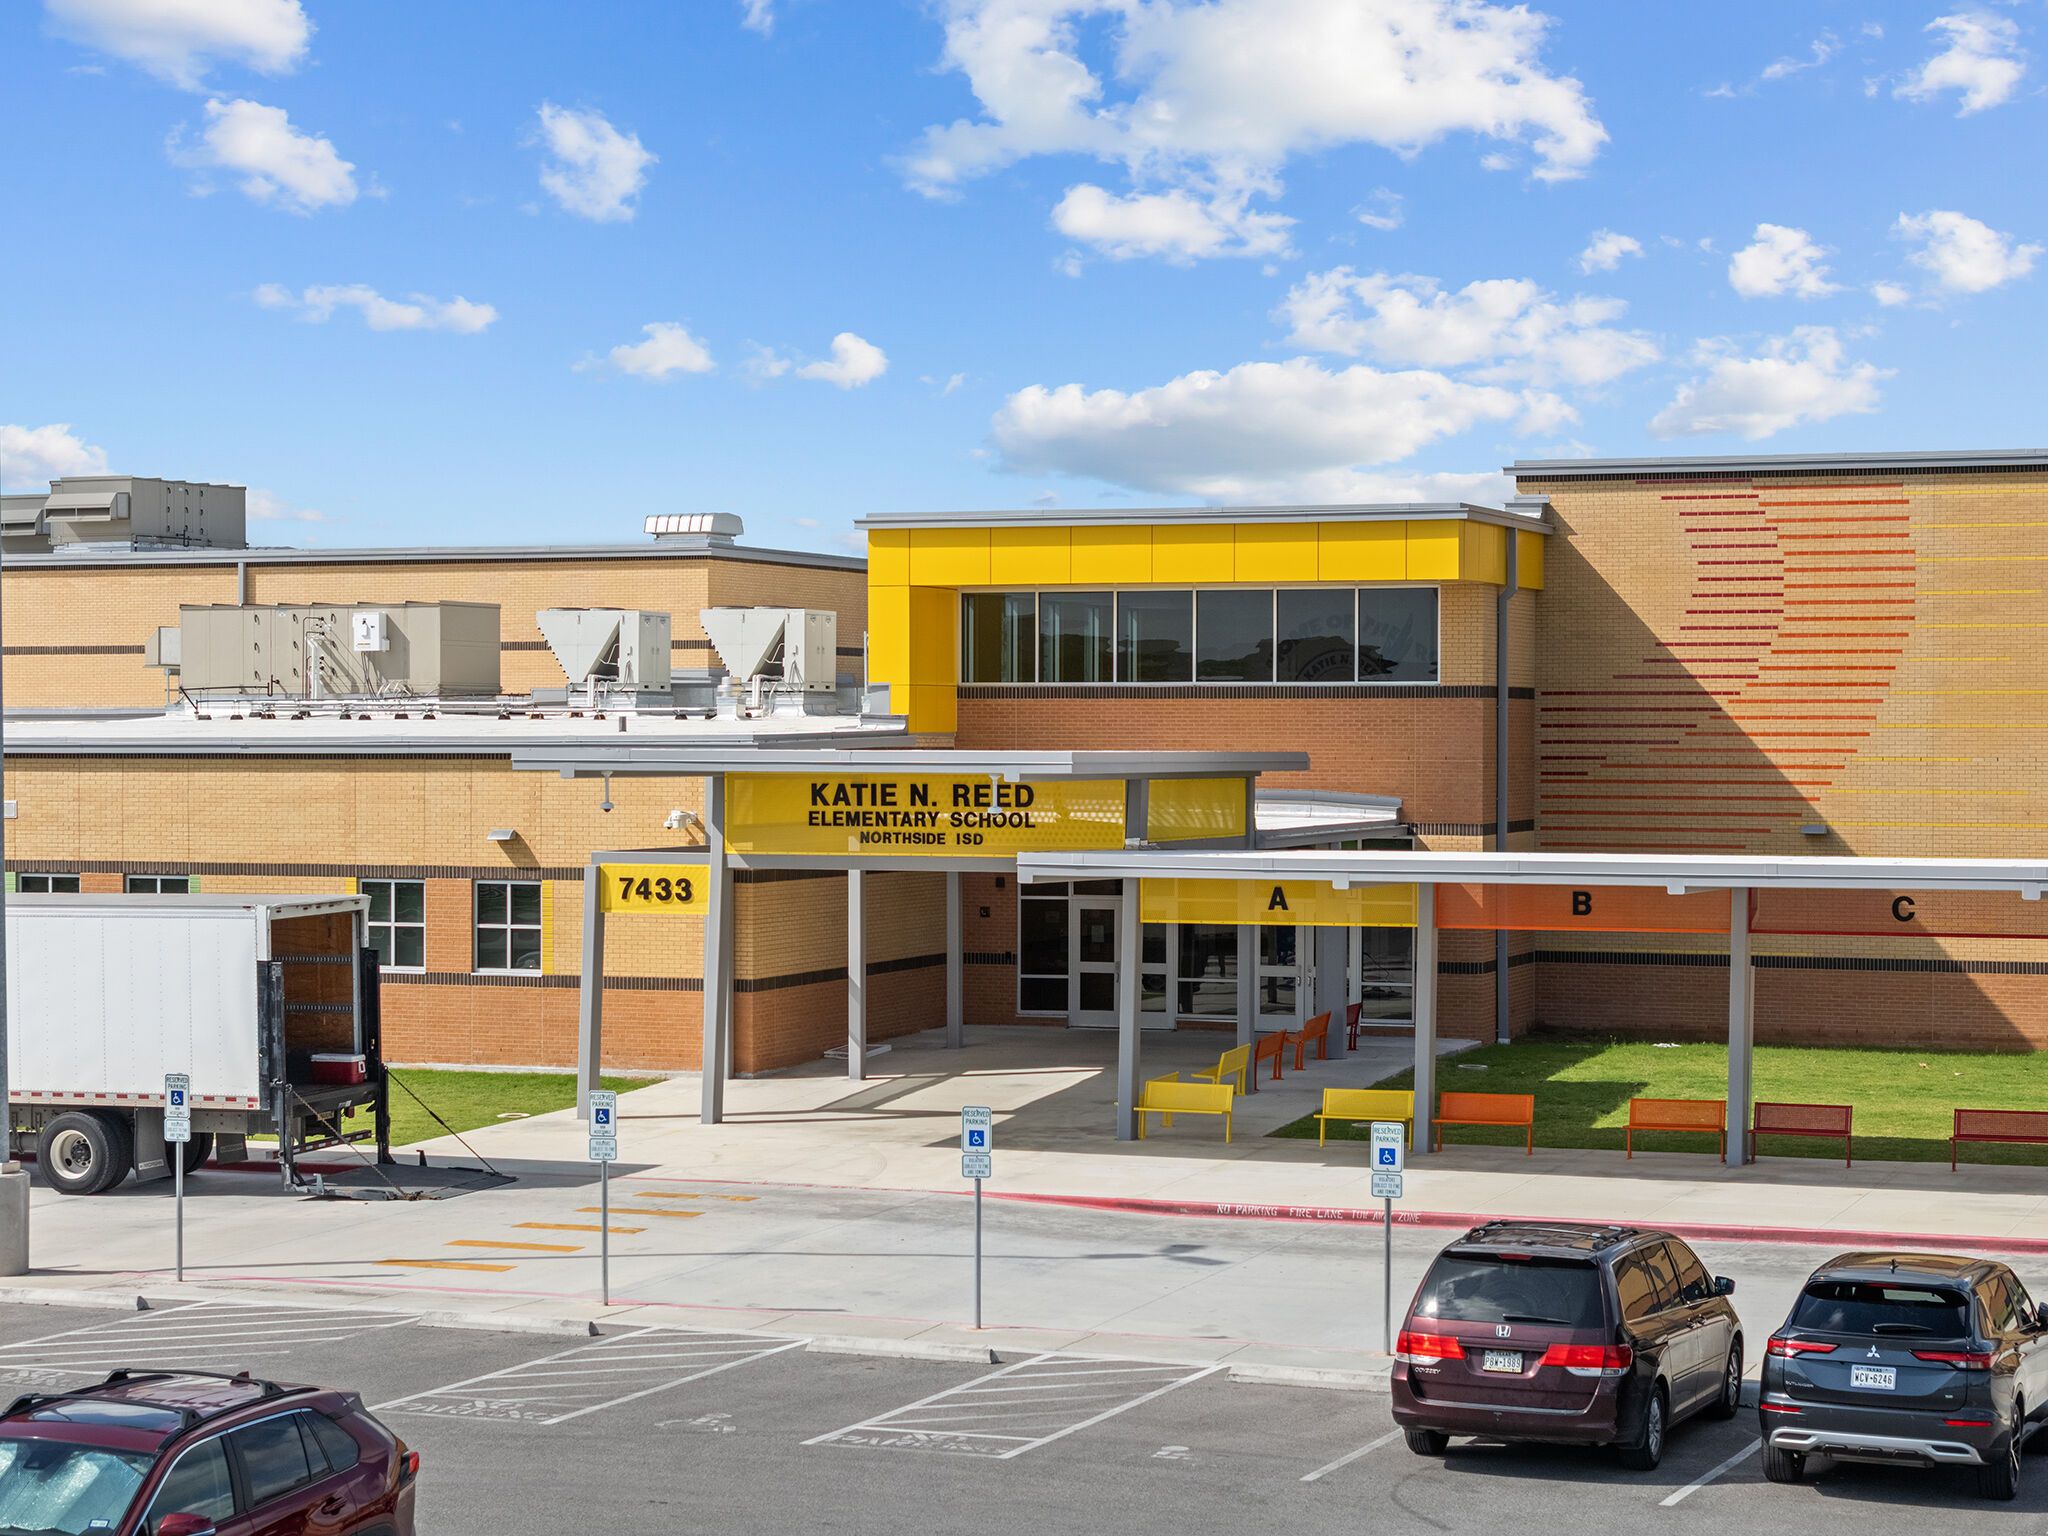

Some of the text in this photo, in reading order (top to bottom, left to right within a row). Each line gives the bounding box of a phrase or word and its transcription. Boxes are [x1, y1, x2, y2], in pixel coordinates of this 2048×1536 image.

[811, 783, 1035, 808] KATIE N. REED
[808, 811, 1036, 829] ELEMENTARY SCHOOL
[860, 831, 984, 845] NORTHSIDE ISD
[619, 877, 693, 902] 7433
[1268, 886, 1289, 911] A
[1572, 891, 1592, 915] B
[1892, 896, 1916, 922] C
[1374, 1127, 1401, 1135] RESERVED
[1217, 1204, 1230, 1215] NO
[1235, 1205, 1278, 1216] PARKING
[1289, 1207, 1312, 1218] FIRE
[1317, 1209, 1344, 1220] LANE
[1351, 1210, 1369, 1220] TOW
[1398, 1212, 1420, 1223] ZONE
